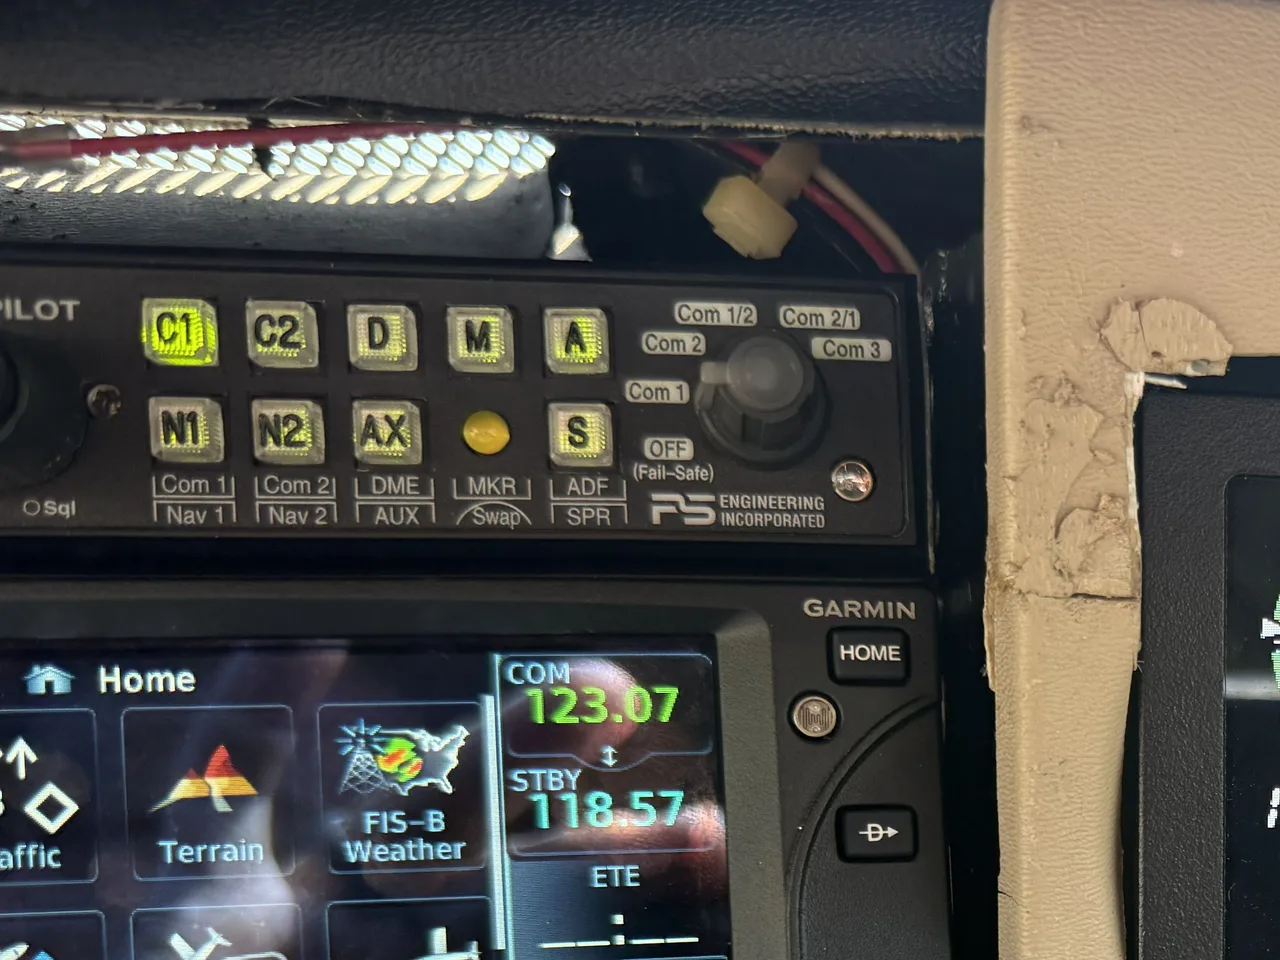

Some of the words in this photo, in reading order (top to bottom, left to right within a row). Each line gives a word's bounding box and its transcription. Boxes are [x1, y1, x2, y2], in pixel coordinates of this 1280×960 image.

[0, 299, 80, 320] ILOT
[676, 304, 723, 324] Com
[728, 303, 754, 325] 1/2
[783, 307, 826, 327] Com
[831, 307, 858, 328] 2/1
[156, 312, 193, 345] C1
[254, 314, 303, 348] C2
[368, 317, 389, 350] D
[465, 320, 492, 353] M
[565, 321, 587, 354] A
[645, 334, 687, 354] Com
[690, 335, 702, 353] 2
[823, 340, 865, 358] Com
[869, 341, 881, 359] 3
[629, 383, 671, 400] Com
[675, 383, 684, 401] 1
[161, 411, 199, 446] N1
[259, 414, 305, 448] N2
[361, 414, 407, 447] AX
[568, 416, 588, 448] S
[650, 440, 687, 459] OFF
[162, 475, 216, 495] Com
[219, 475, 227, 494] 1
[264, 476, 312, 495] Com
[316, 477, 330, 495] 2
[372, 477, 420, 495] DME
[469, 478, 516, 495] MKR
[567, 478, 609, 496] ADF
[720, 495, 825, 511] ENGINEERING
[167, 506, 214, 524] Nav
[218, 506, 225, 524] 1
[269, 507, 311, 525] Nav
[314, 507, 328, 524] 2
[375, 508, 420, 525] AUX
[473, 507, 521, 530] Swap
[567, 508, 611, 526] SPR
[721, 511, 825, 528] INCORPORATED
[803, 599, 916, 620] GARMIN
[840, 644, 902, 662] HOME
[100, 665, 196, 694] Home
[505, 662, 571, 684] COM
[525, 686, 680, 725] 123.07
[509, 769, 583, 792] STBY
[528, 790, 686, 830] 118.57
[362, 811, 446, 835] FIS-B
[158, 840, 264, 864] Terrain
[342, 838, 467, 864] Weather
[590, 866, 642, 888] ETE
